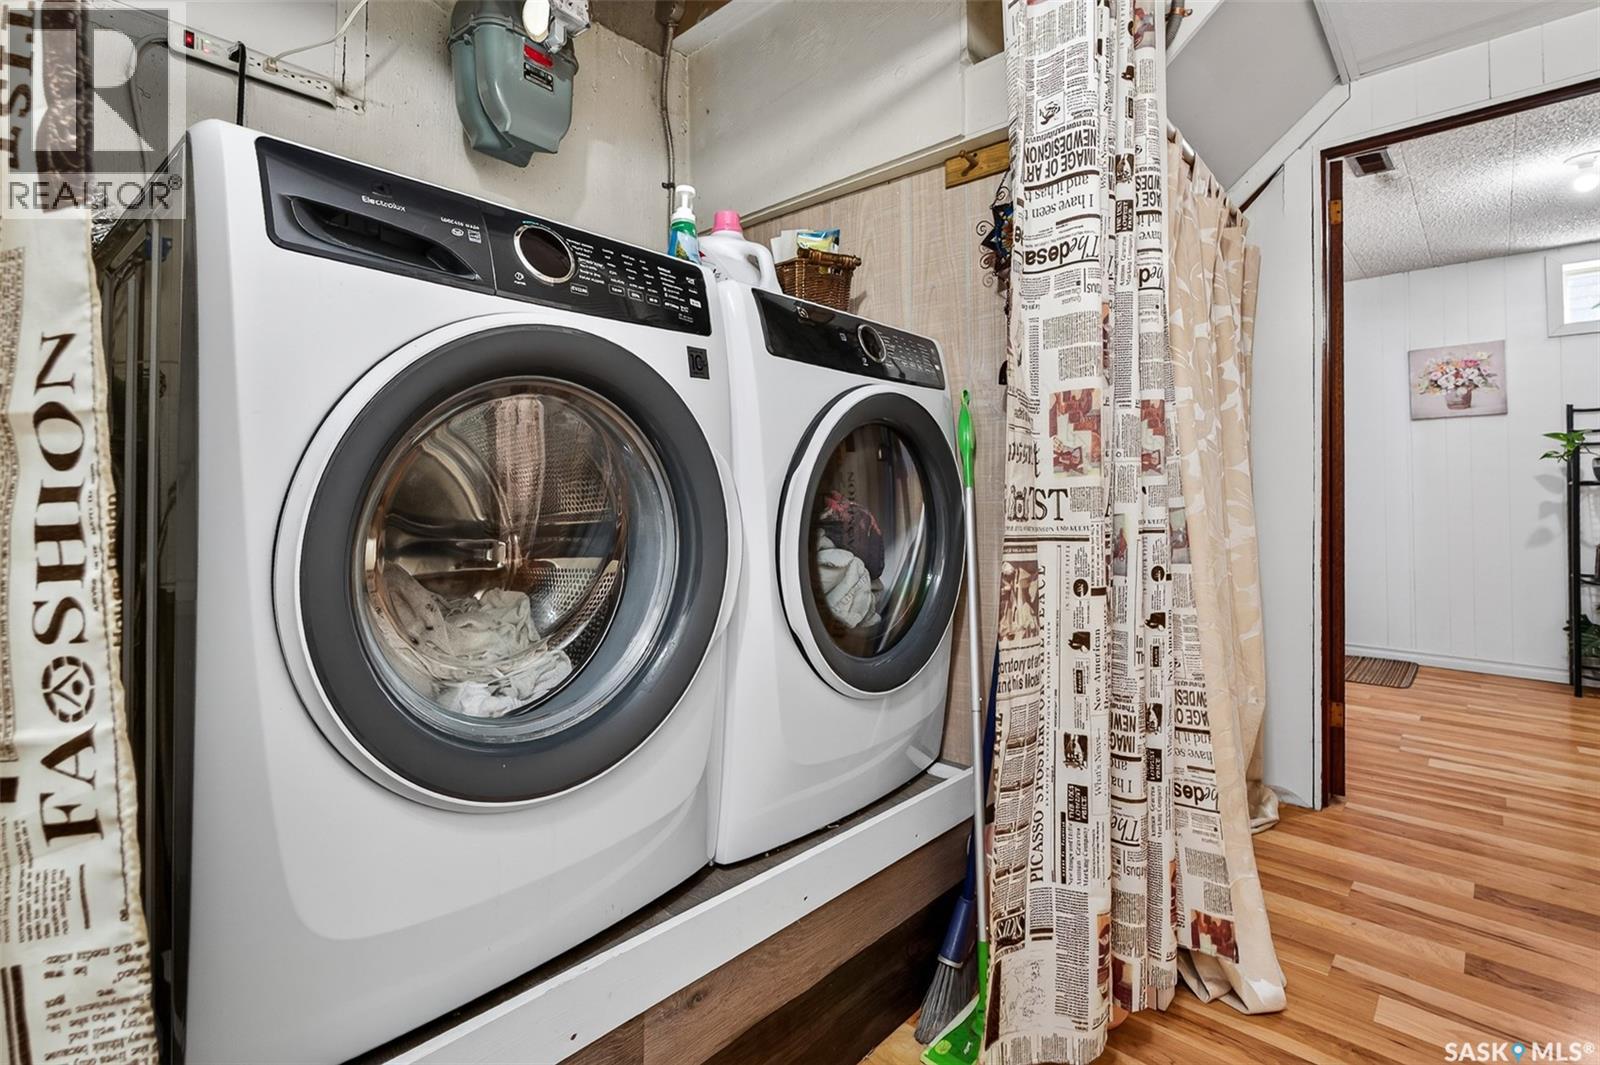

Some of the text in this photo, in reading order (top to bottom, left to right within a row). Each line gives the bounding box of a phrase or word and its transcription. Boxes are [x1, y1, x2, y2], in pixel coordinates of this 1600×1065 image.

[1045, 158, 1058, 178] OF
[1061, 148, 1096, 172] IMAGE
[361, 195, 406, 212] Electrolux
[1031, 203, 1056, 219] seen
[1058, 194, 1085, 211] have
[1091, 628, 1101, 682] American
